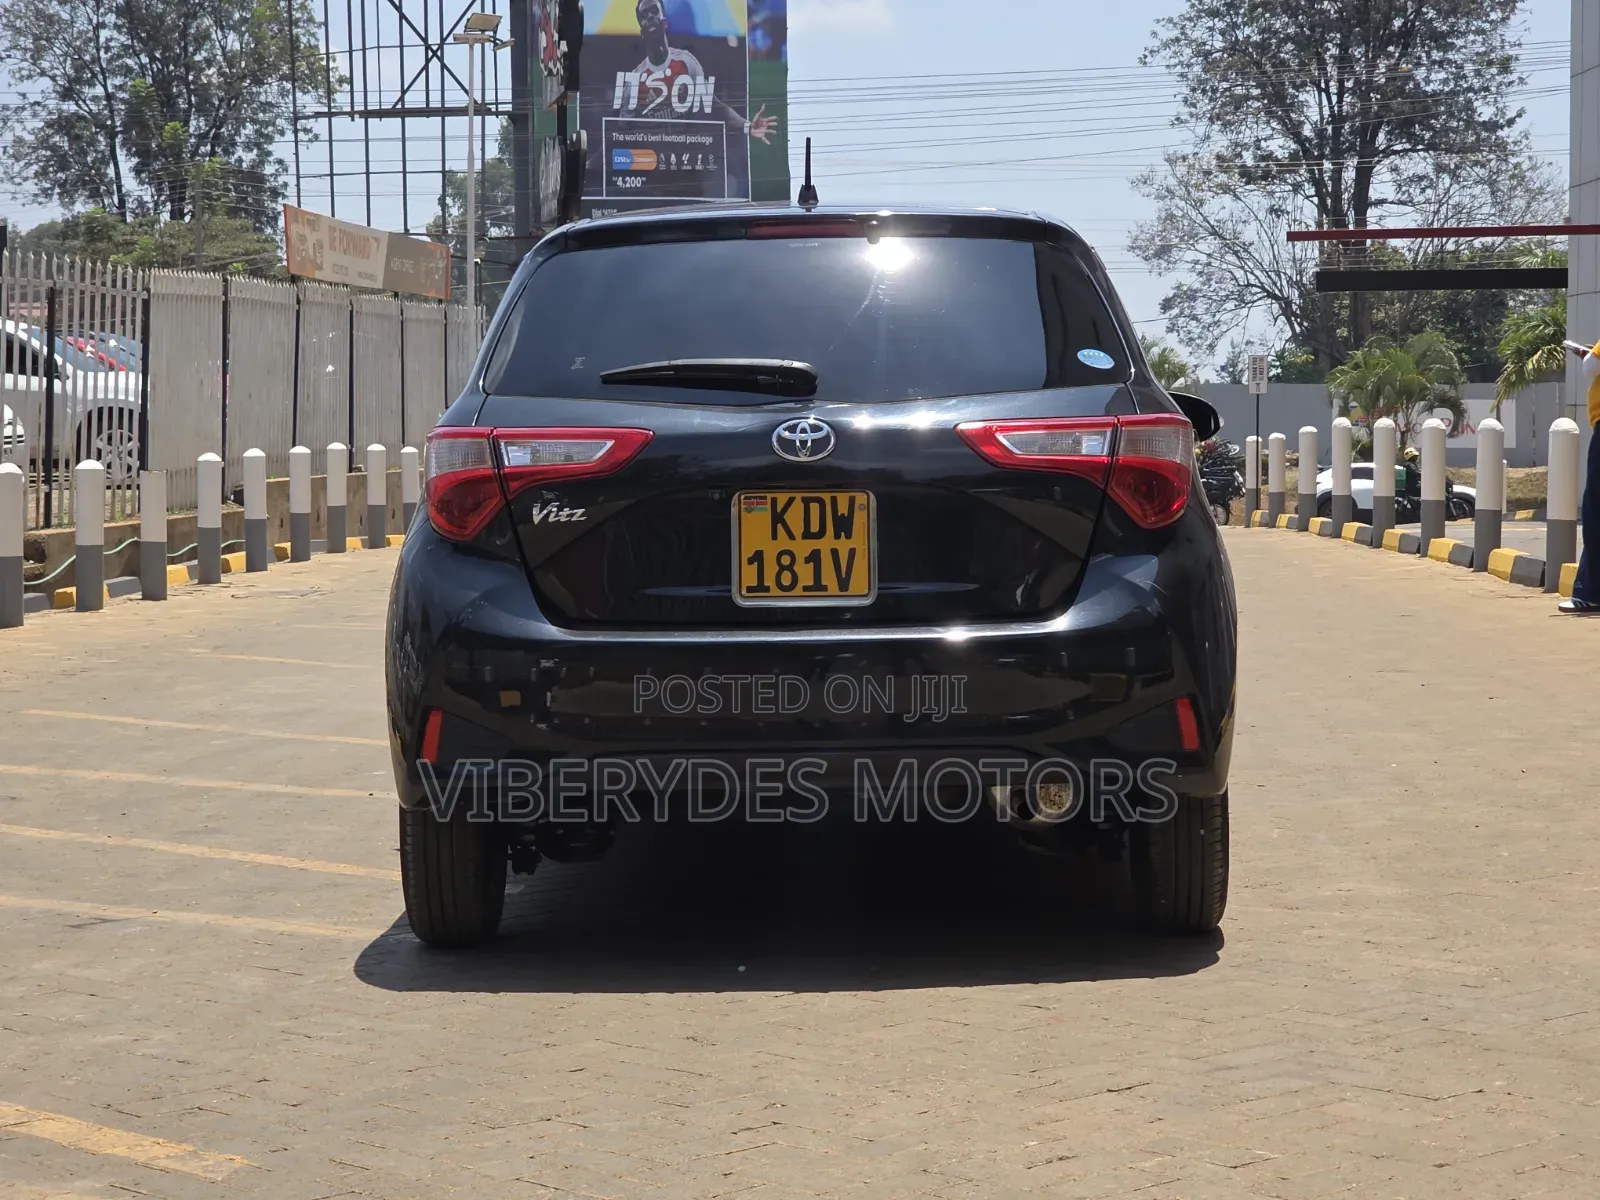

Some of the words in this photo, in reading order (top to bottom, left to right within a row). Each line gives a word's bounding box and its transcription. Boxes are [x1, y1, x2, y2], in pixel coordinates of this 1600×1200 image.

[613, 68, 671, 115] IT'S
[671, 74, 715, 113] ON
[612, 133, 624, 141] The
[625, 133, 647, 141] world's
[648, 133, 662, 142] best
[662, 133, 686, 143] football
[687, 135, 713, 146] package
[617, 176, 642, 188] 4,200
[338, 227, 371, 260] FORWARD
[532, 502, 588, 525] Vitz
[770, 496, 856, 540] KDW
[746, 547, 857, 593] 181V
